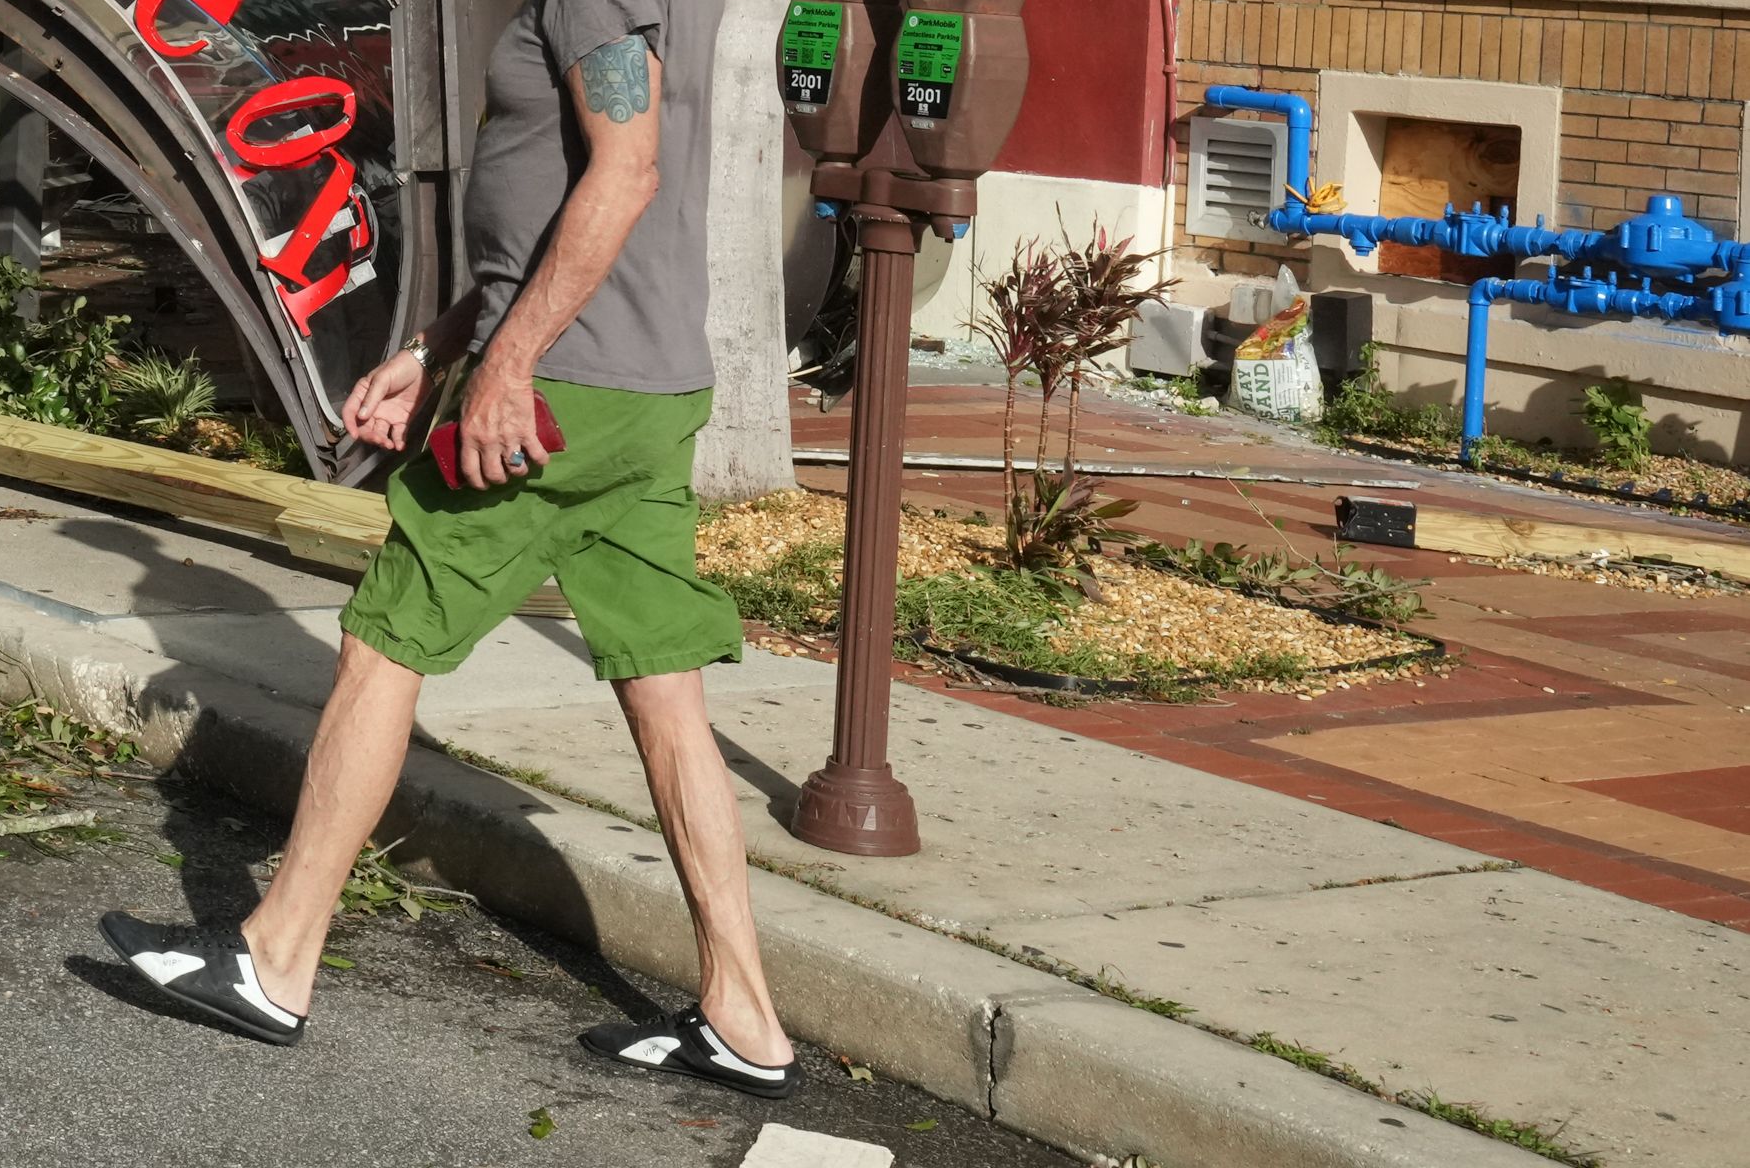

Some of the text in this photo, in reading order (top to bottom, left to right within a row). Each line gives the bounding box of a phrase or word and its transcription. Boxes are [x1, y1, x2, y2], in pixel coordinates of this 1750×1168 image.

[802, 7, 835, 16] ParkMobile
[788, 19, 838, 30] Contactless Parking
[919, 18, 956, 28] ParkMobile
[903, 31, 959, 42] Contactless Parking
[791, 73, 821, 89] 2001
[907, 87, 940, 104] 2001
[1237, 369, 1254, 414] PLAY
[1254, 363, 1273, 418] SAND
[643, 1044, 658, 1056] VIP
